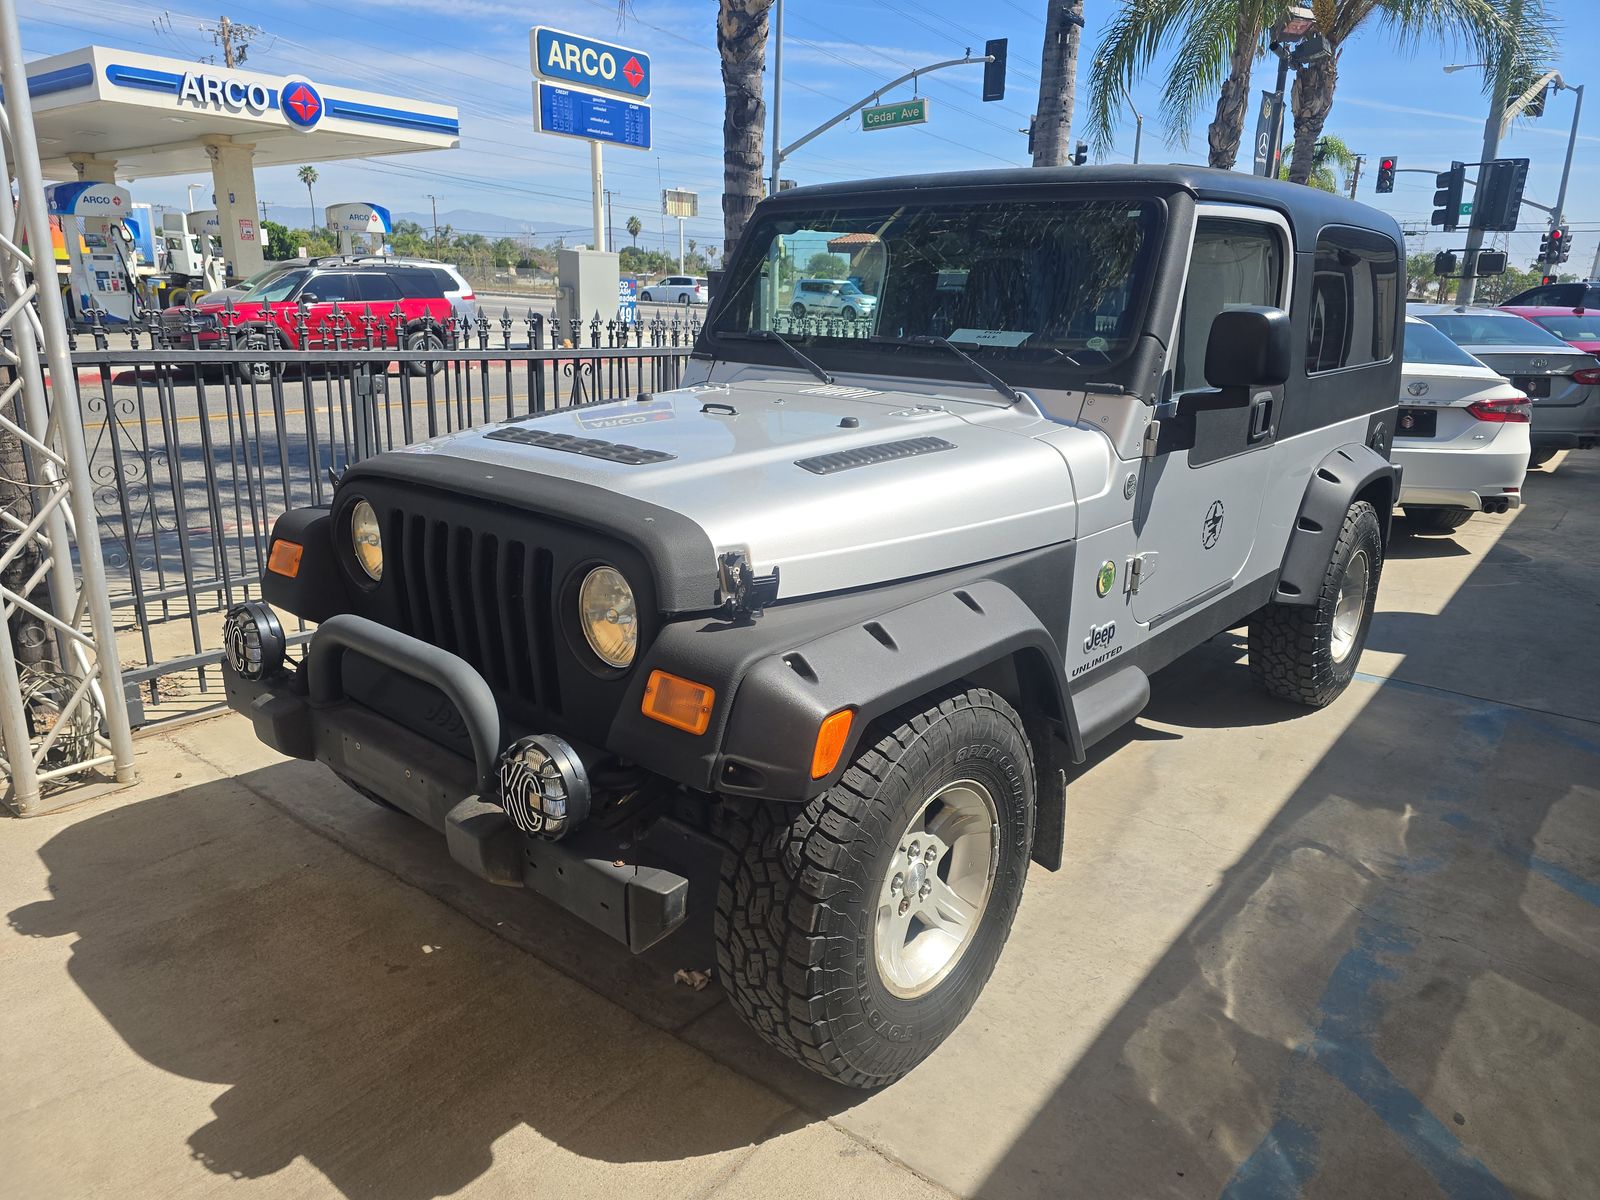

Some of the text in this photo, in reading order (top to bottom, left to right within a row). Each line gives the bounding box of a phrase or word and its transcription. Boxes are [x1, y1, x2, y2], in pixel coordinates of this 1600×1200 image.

[548, 40, 616, 80] ARCO
[180, 71, 270, 111] ARCO
[867, 108, 920, 123] Cedar Ave
[83, 195, 110, 204] ARCO
[349, 213, 370, 222] ARCO
[619, 280, 629, 288] CO
[1083, 621, 1116, 654] Jeep
[1072, 646, 1123, 677] UNLIMITED
[954, 744, 1001, 765] OPEN
[501, 762, 543, 832] KC
